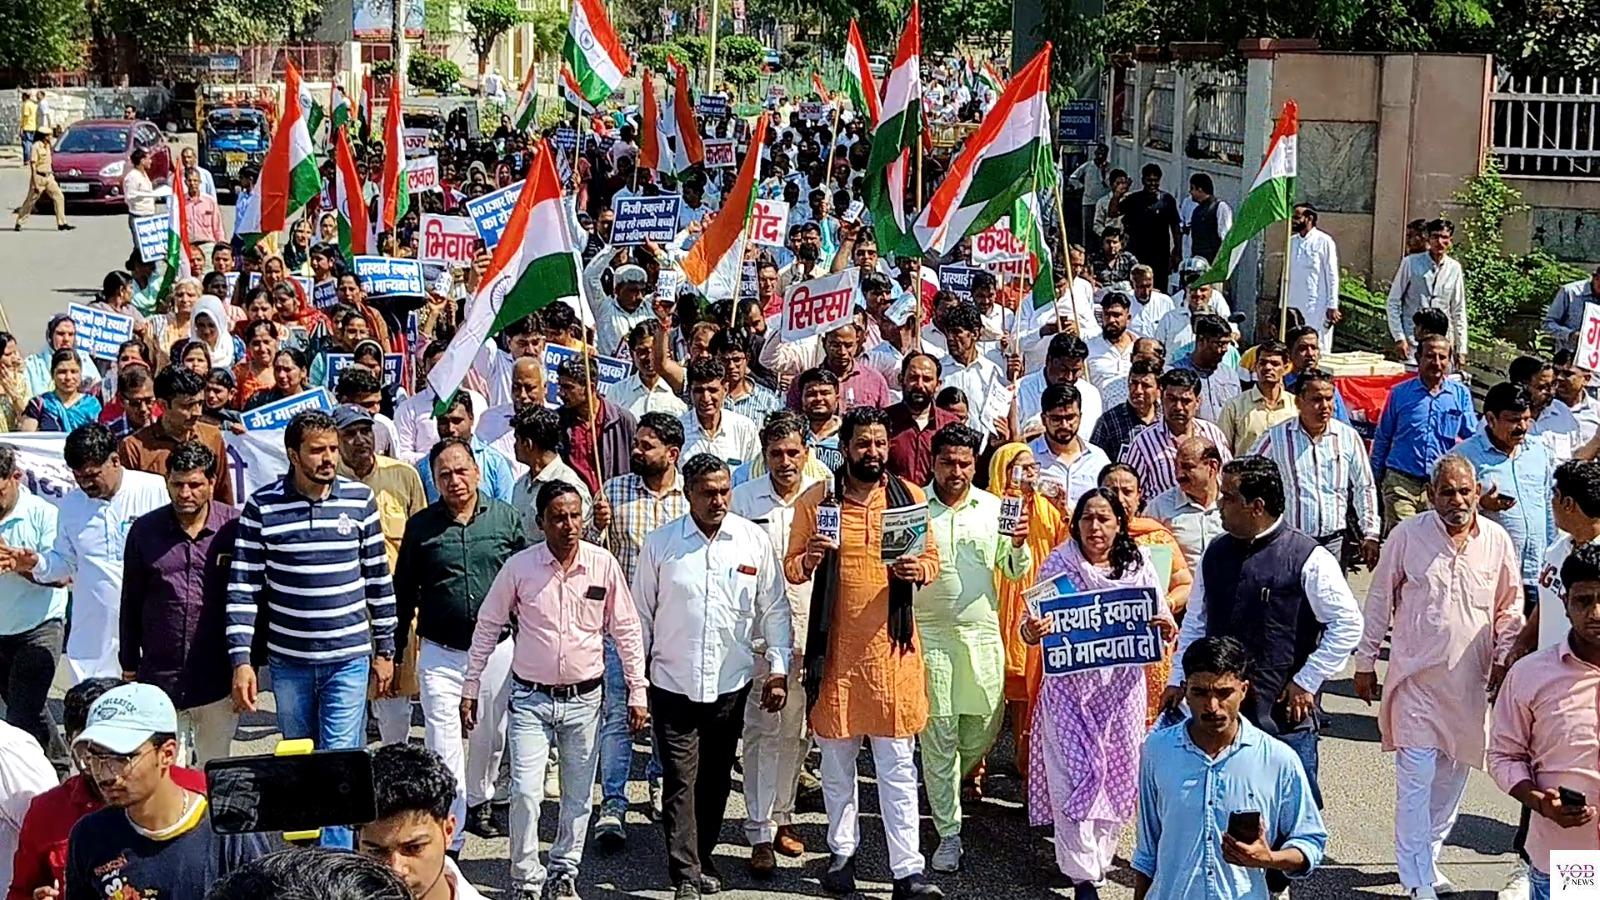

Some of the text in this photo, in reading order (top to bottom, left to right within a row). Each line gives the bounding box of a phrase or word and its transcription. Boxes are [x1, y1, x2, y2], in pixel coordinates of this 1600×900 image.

[407, 167, 436, 190] लवल
[472, 204, 485, 218] 60
[620, 201, 642, 215] निजी
[751, 202, 782, 242] ींद
[481, 215, 498, 231] का
[425, 218, 477, 260] भिवा
[788, 286, 853, 331] सिरसा
[545, 351, 627, 380] 60 क्षको
[250, 410, 274, 428] गैर
[1044, 595, 1102, 633] अस्थाई
[1102, 590, 1154, 631] स्कूलो
[1047, 626, 1156, 669] को मान्यता दो
